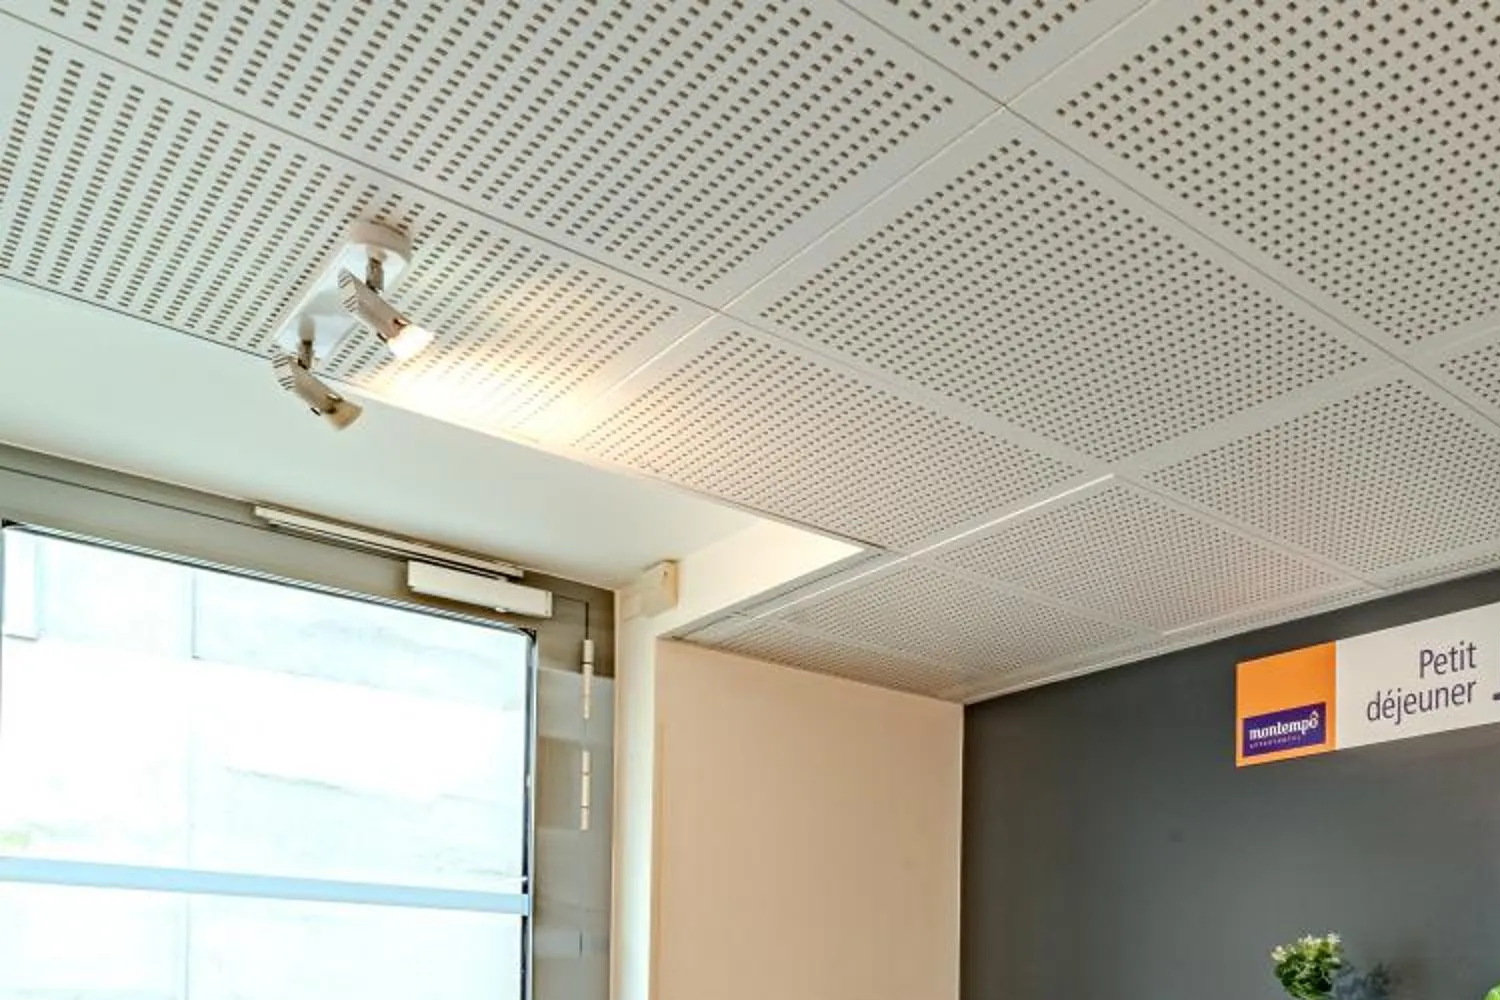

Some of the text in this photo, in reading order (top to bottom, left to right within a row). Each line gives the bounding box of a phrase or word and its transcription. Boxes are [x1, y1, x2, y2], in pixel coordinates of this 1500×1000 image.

[1419, 640, 1477, 679] Petit
[1366, 680, 1477, 726] déjeuner
[1248, 709, 1319, 741] montempô
